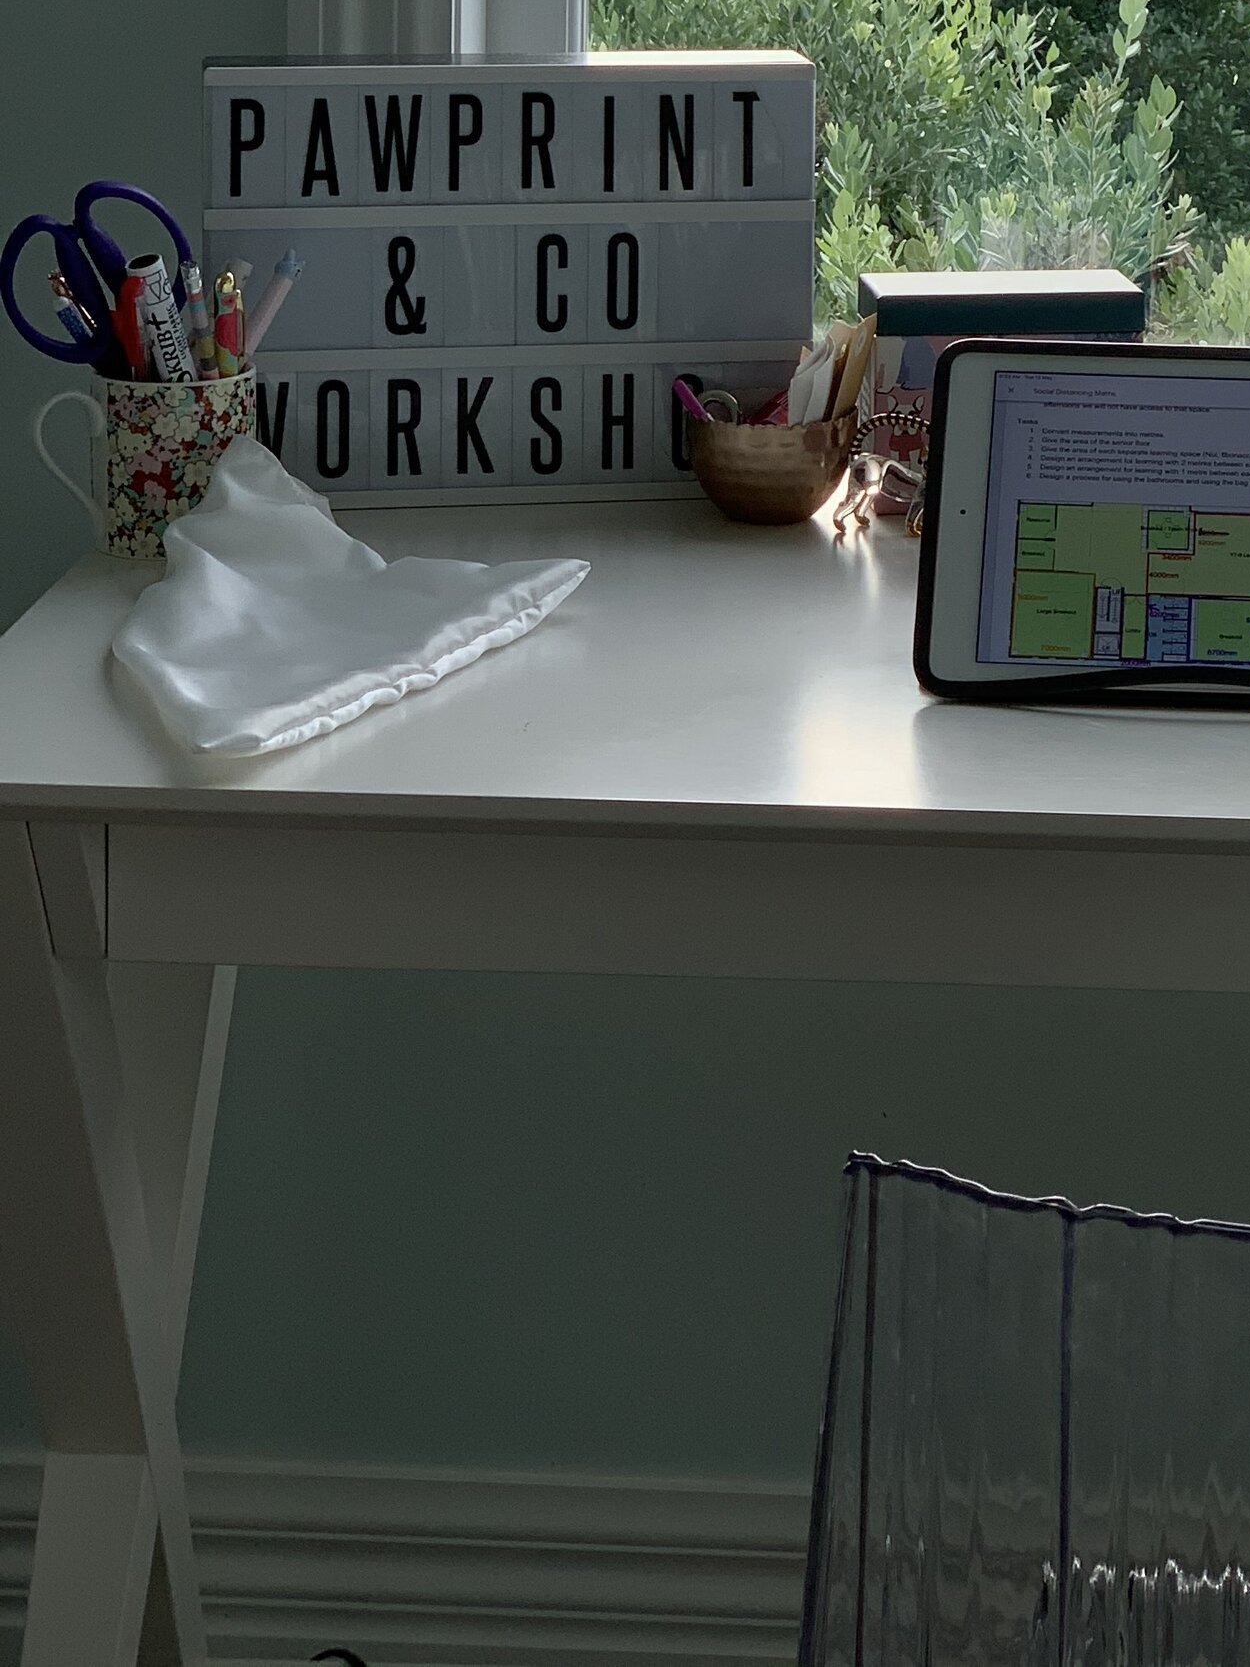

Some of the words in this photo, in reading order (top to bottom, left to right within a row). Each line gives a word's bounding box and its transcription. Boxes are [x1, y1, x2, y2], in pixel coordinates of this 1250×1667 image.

[230, 91, 760, 197] PAWPRINT
[385, 236, 427, 335] &
[536, 233, 639, 333] CO
[1056, 389, 1093, 397] Distancing
[1040, 455, 1065, 463] Design
[1040, 464, 1065, 472] Design
[1039, 473, 1064, 481] Design
